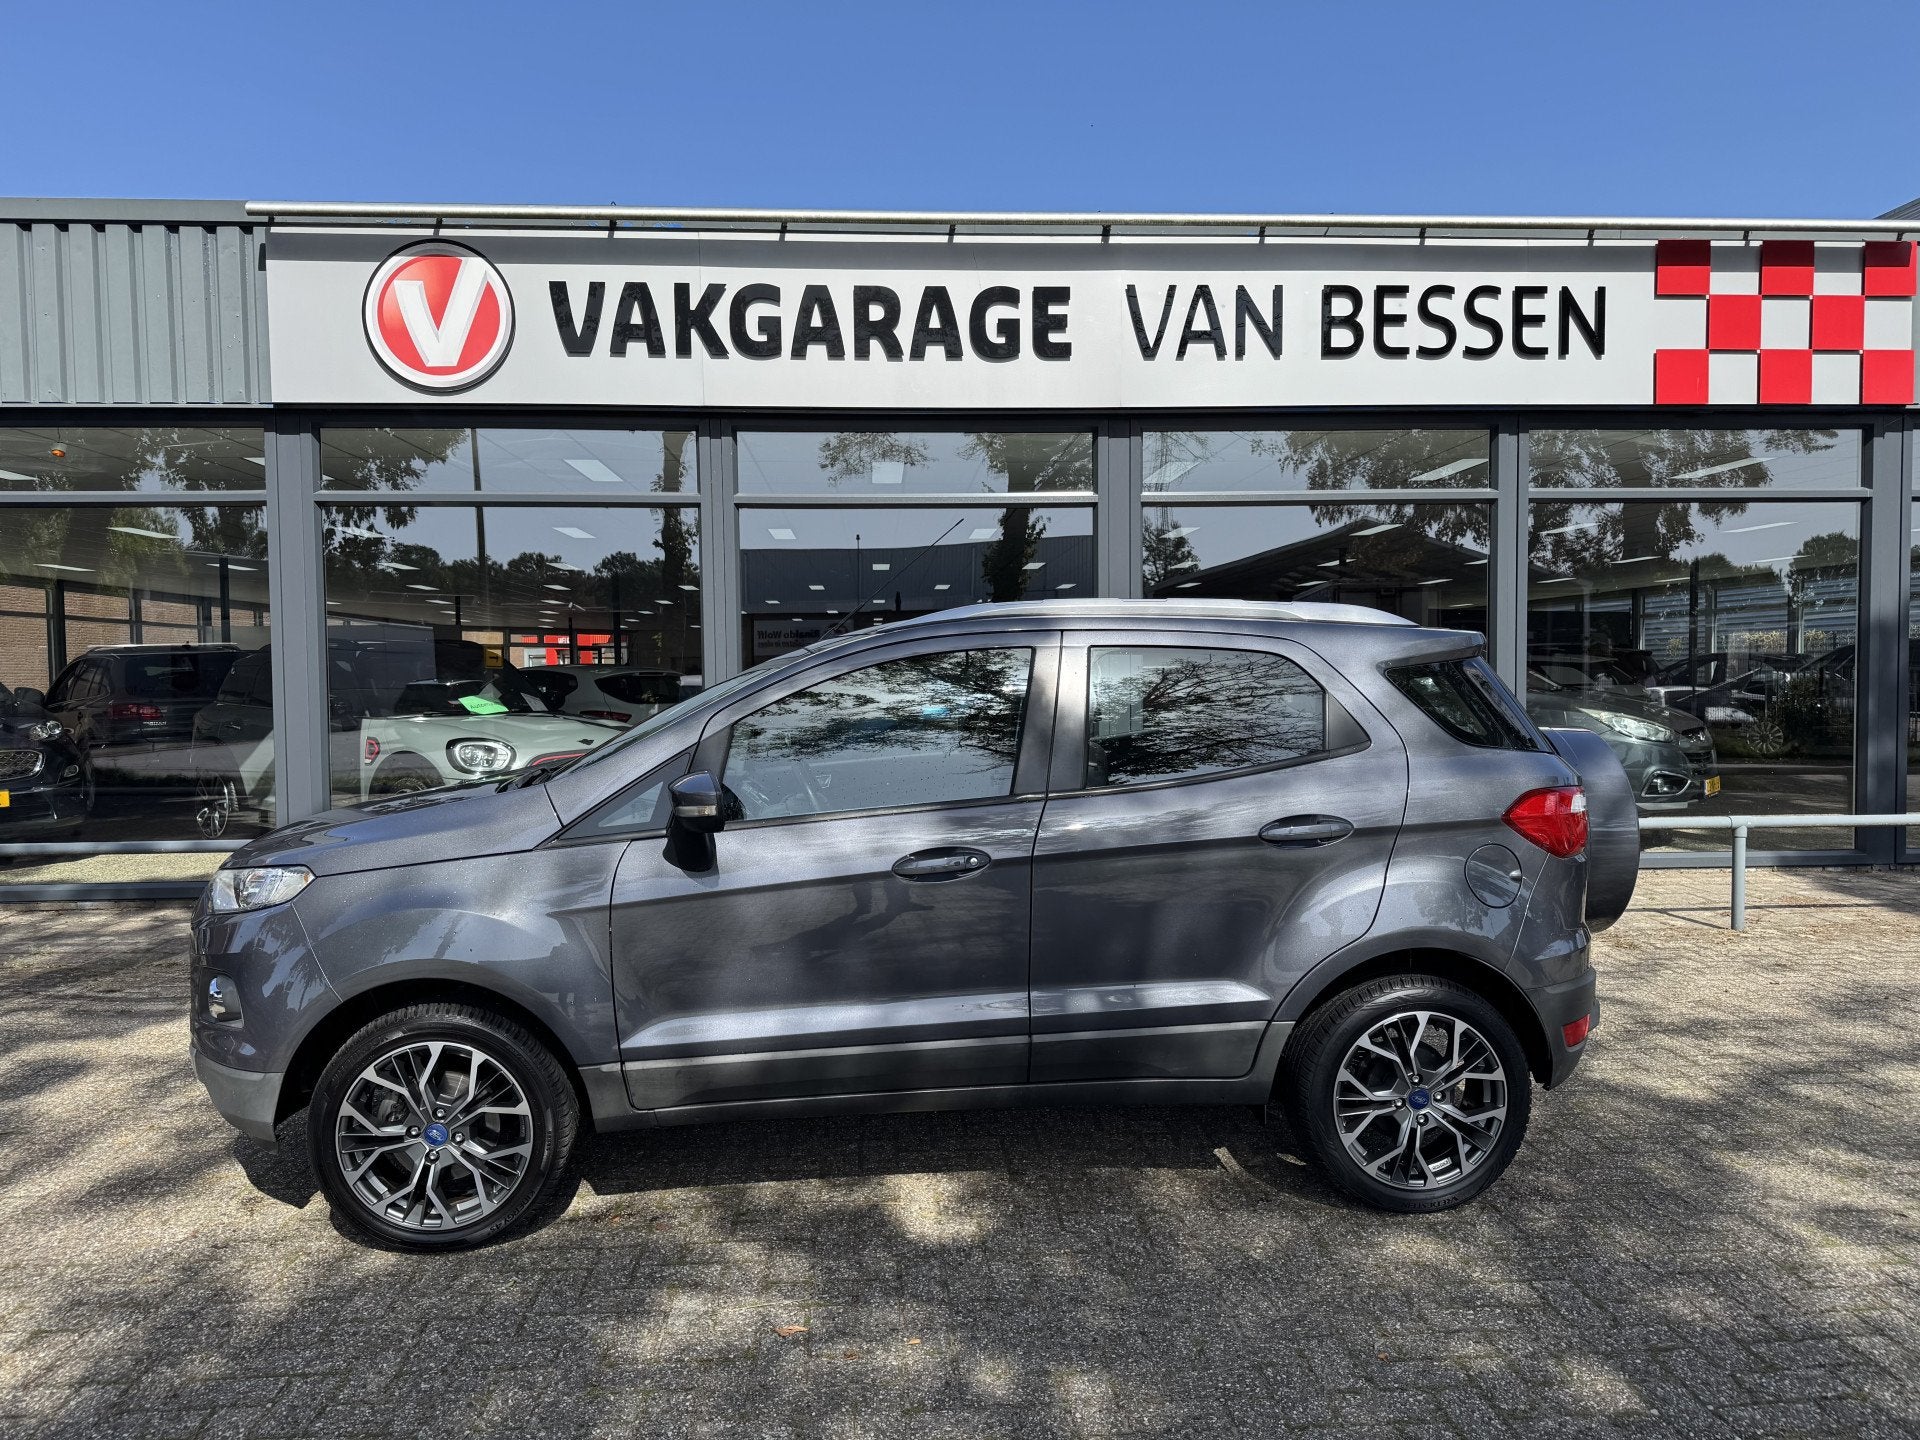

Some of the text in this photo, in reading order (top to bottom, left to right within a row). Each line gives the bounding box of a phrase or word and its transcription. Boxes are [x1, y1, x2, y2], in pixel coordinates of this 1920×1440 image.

[549, 281, 1606, 361] VAKGARAGE VAN BESSEN
